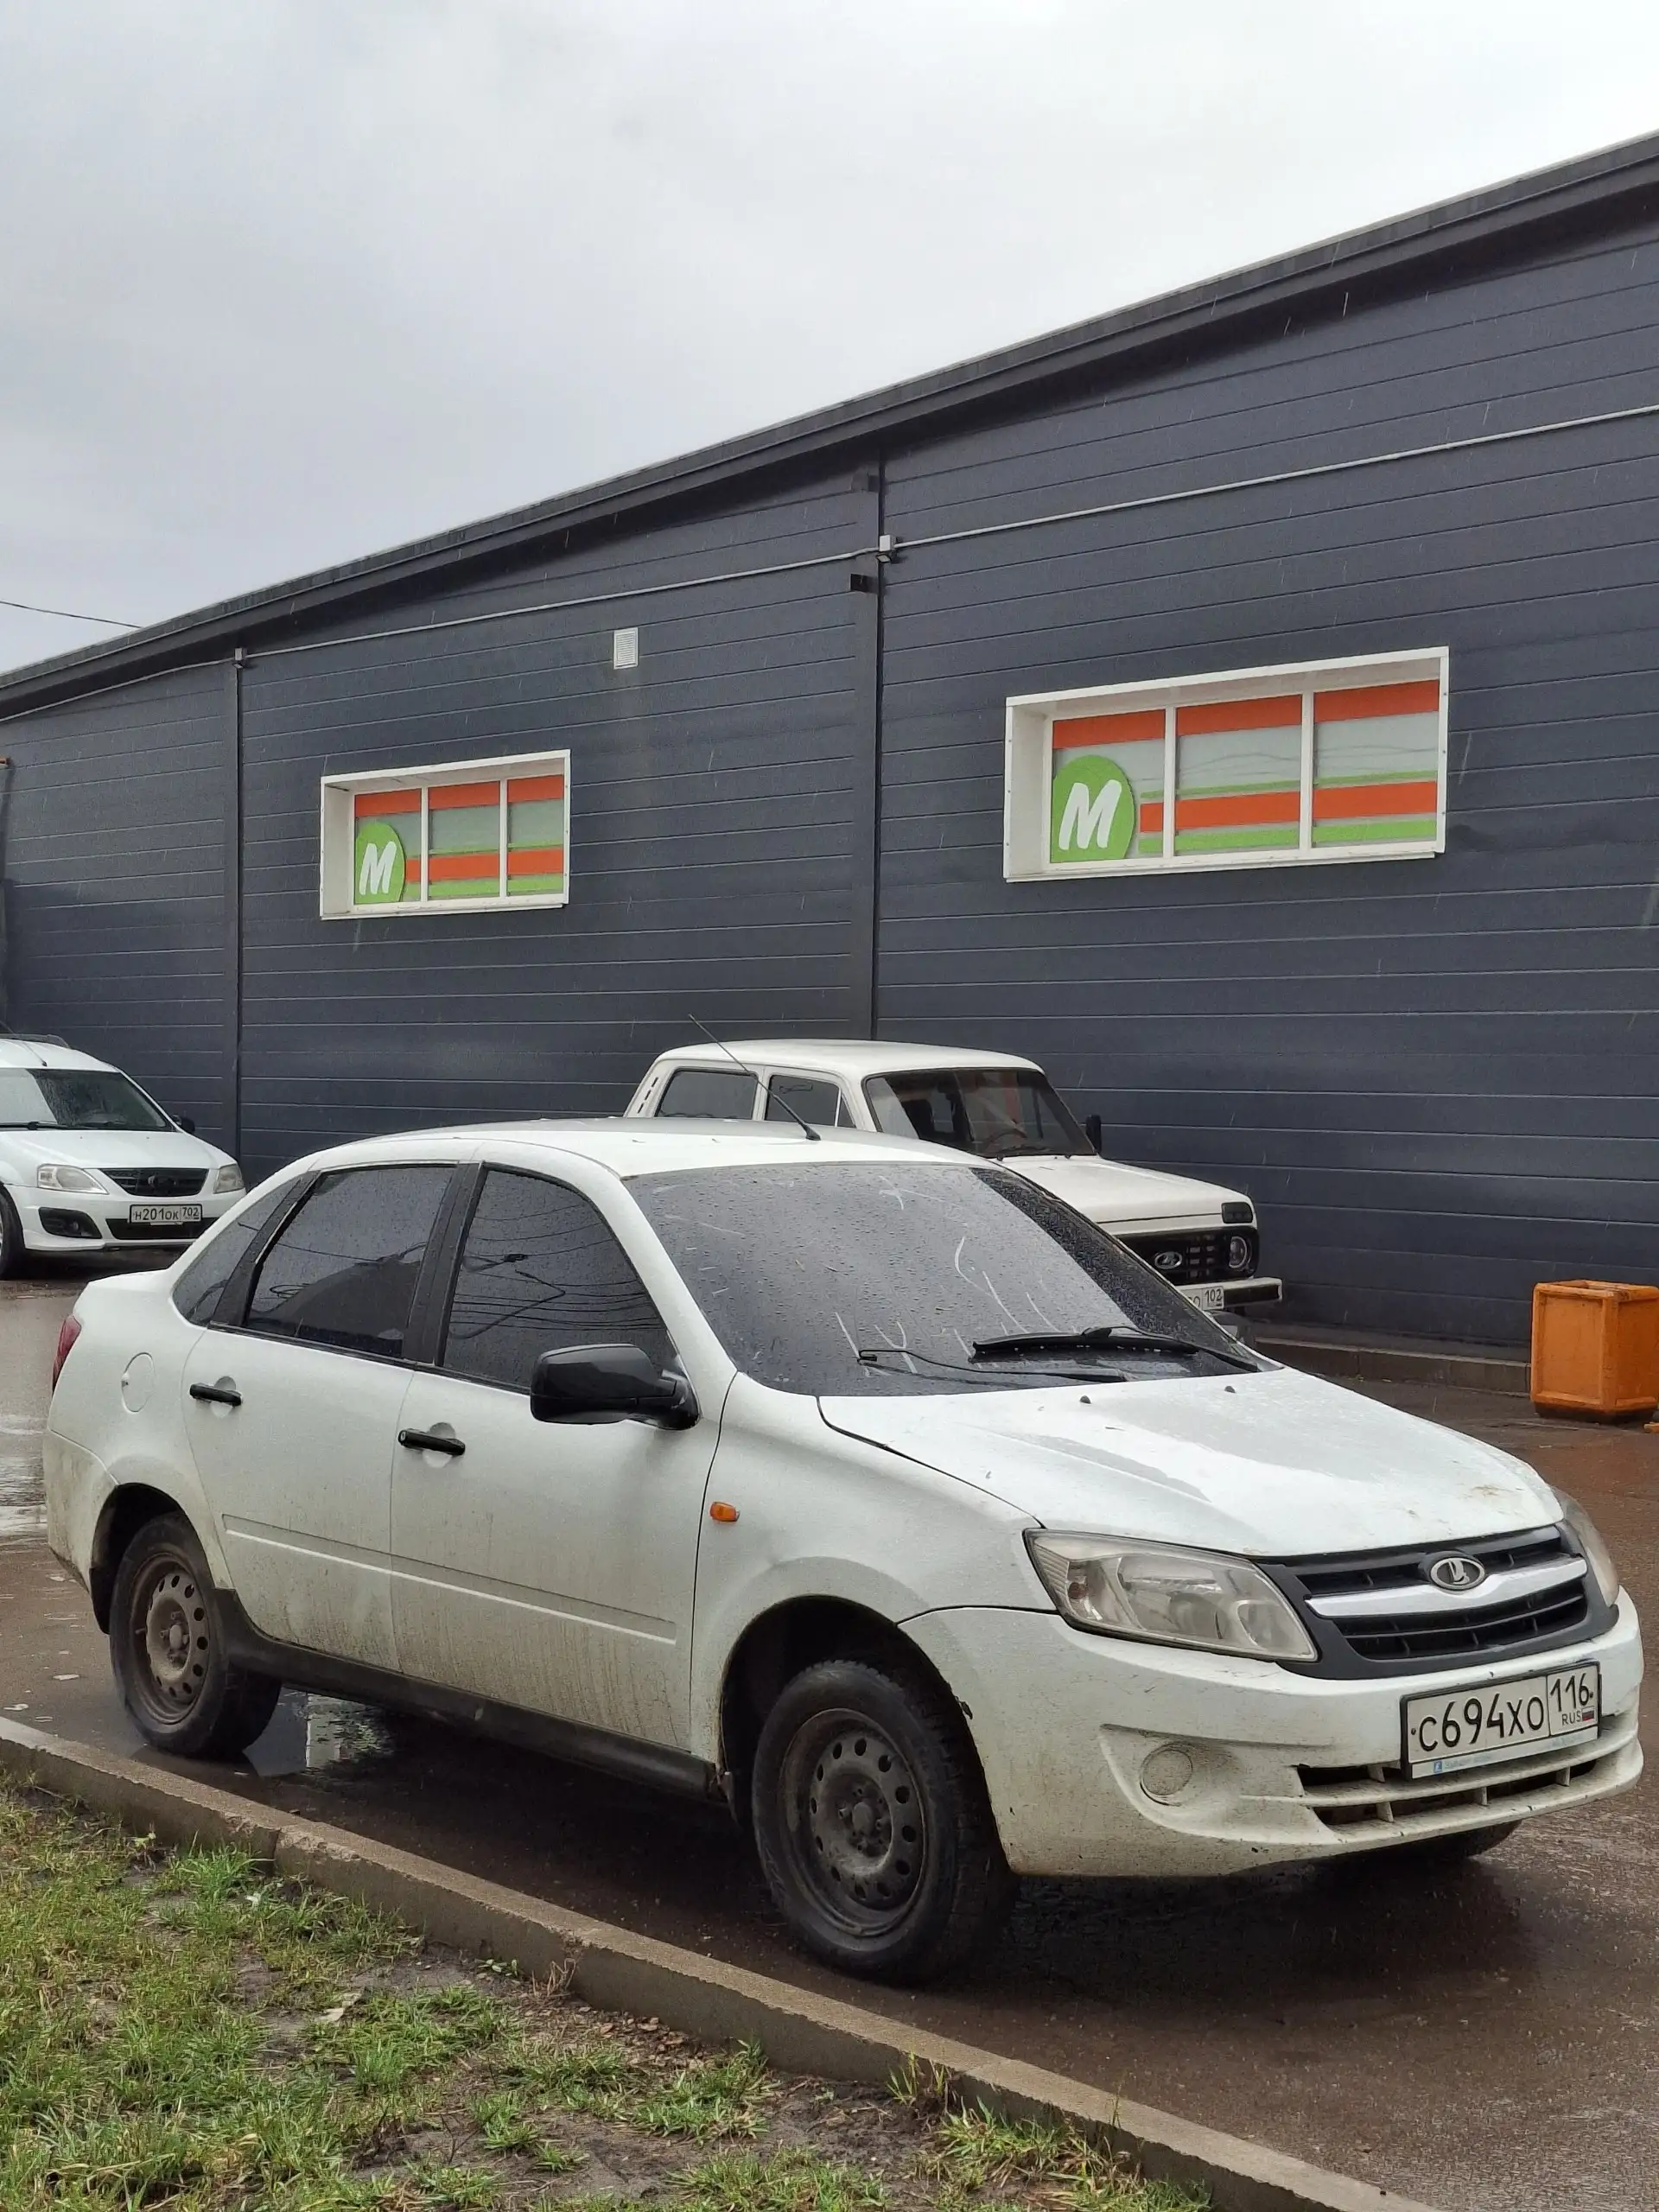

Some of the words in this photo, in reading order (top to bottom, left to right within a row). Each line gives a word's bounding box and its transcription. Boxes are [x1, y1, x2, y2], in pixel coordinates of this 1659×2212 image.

[1058, 779, 1122, 850] М
[359, 841, 397, 895] М
[135, 1208, 179, 1220] Н201ОК
[182, 1207, 199, 1217] 702
[1205, 1288, 1223, 1302] 102
[1419, 1693, 1544, 1751] С694ХО
[1550, 1673, 1590, 1713] 116
[1561, 1710, 1582, 1726] RUS
